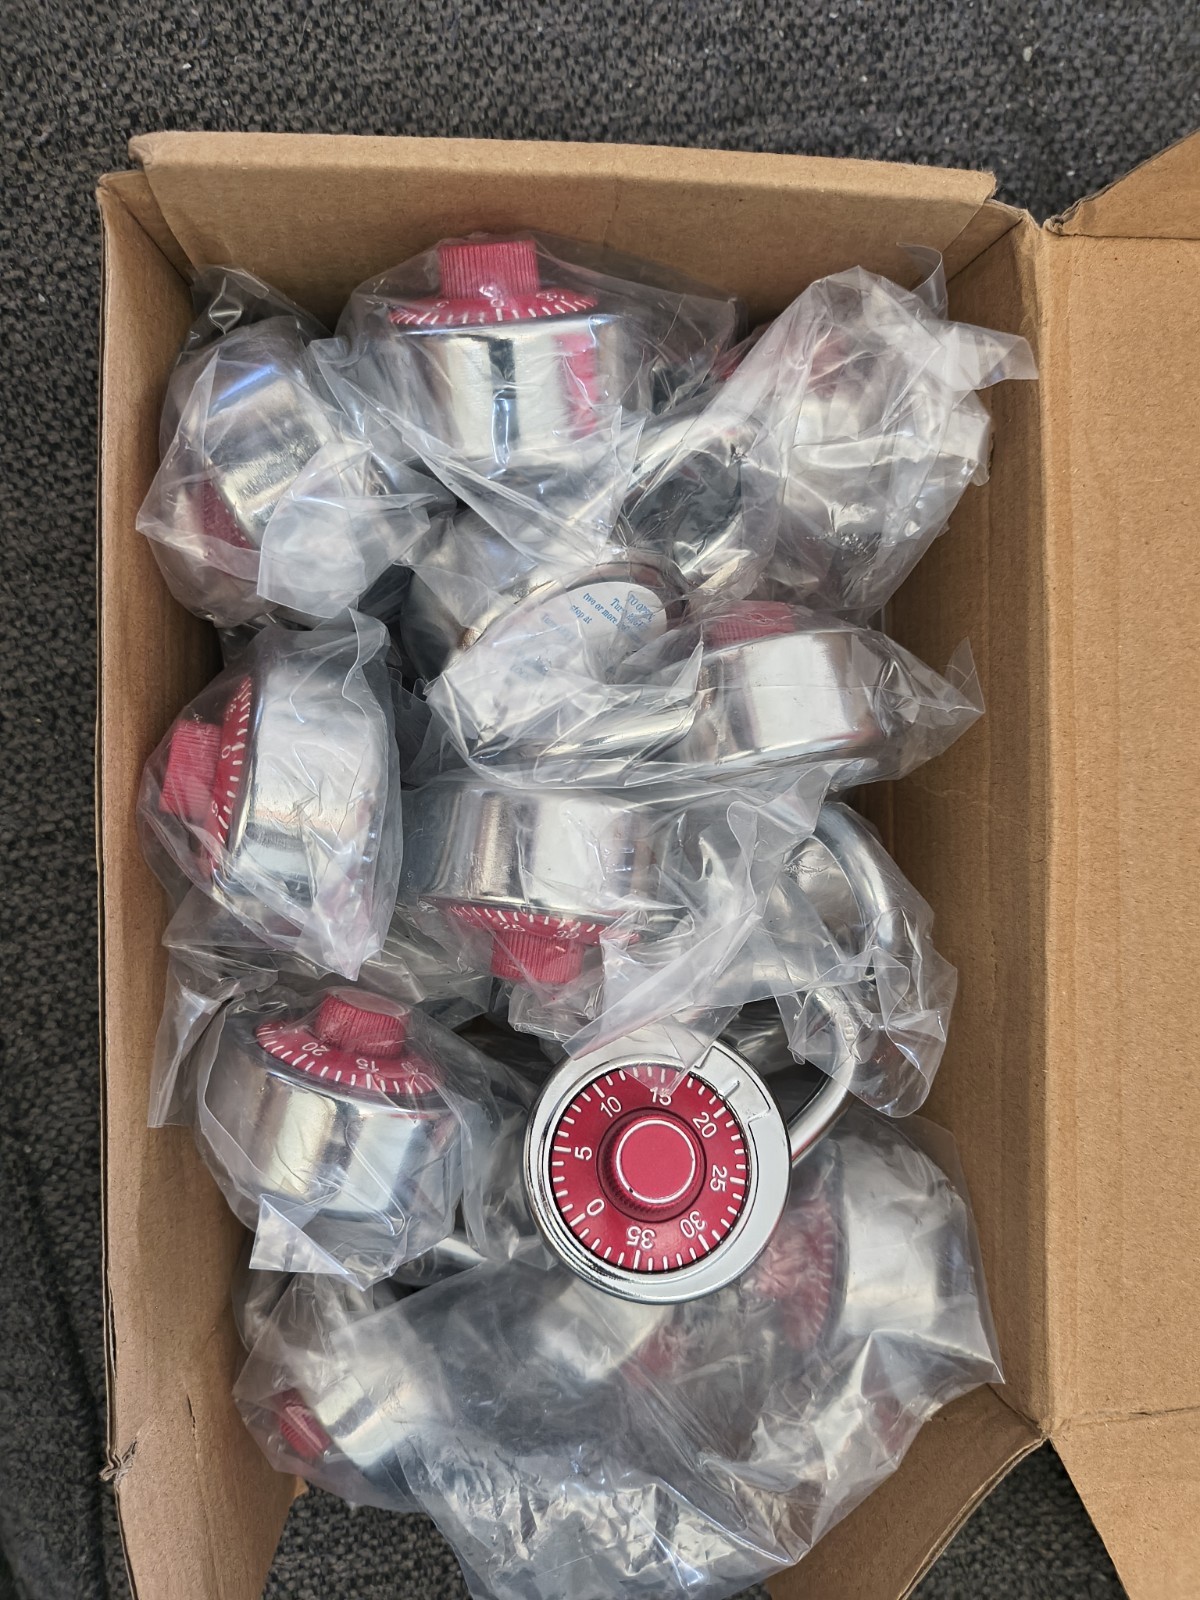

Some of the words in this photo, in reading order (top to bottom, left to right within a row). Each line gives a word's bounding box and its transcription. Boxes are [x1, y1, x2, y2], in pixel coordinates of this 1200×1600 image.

[583, 592, 597, 606] two
[594, 603, 604, 612] or
[601, 609, 618, 625] more
[301, 1041, 329, 1057] 20
[355, 1057, 380, 1074] 15
[600, 1096, 622, 1118] 10
[650, 1087, 672, 1106] 15
[692, 1111, 718, 1139] 20
[574, 1145, 593, 1161] 5
[710, 1164, 728, 1193] 25
[586, 1198, 605, 1216] 0
[680, 1210, 708, 1239] 30
[626, 1226, 656, 1249] 35
